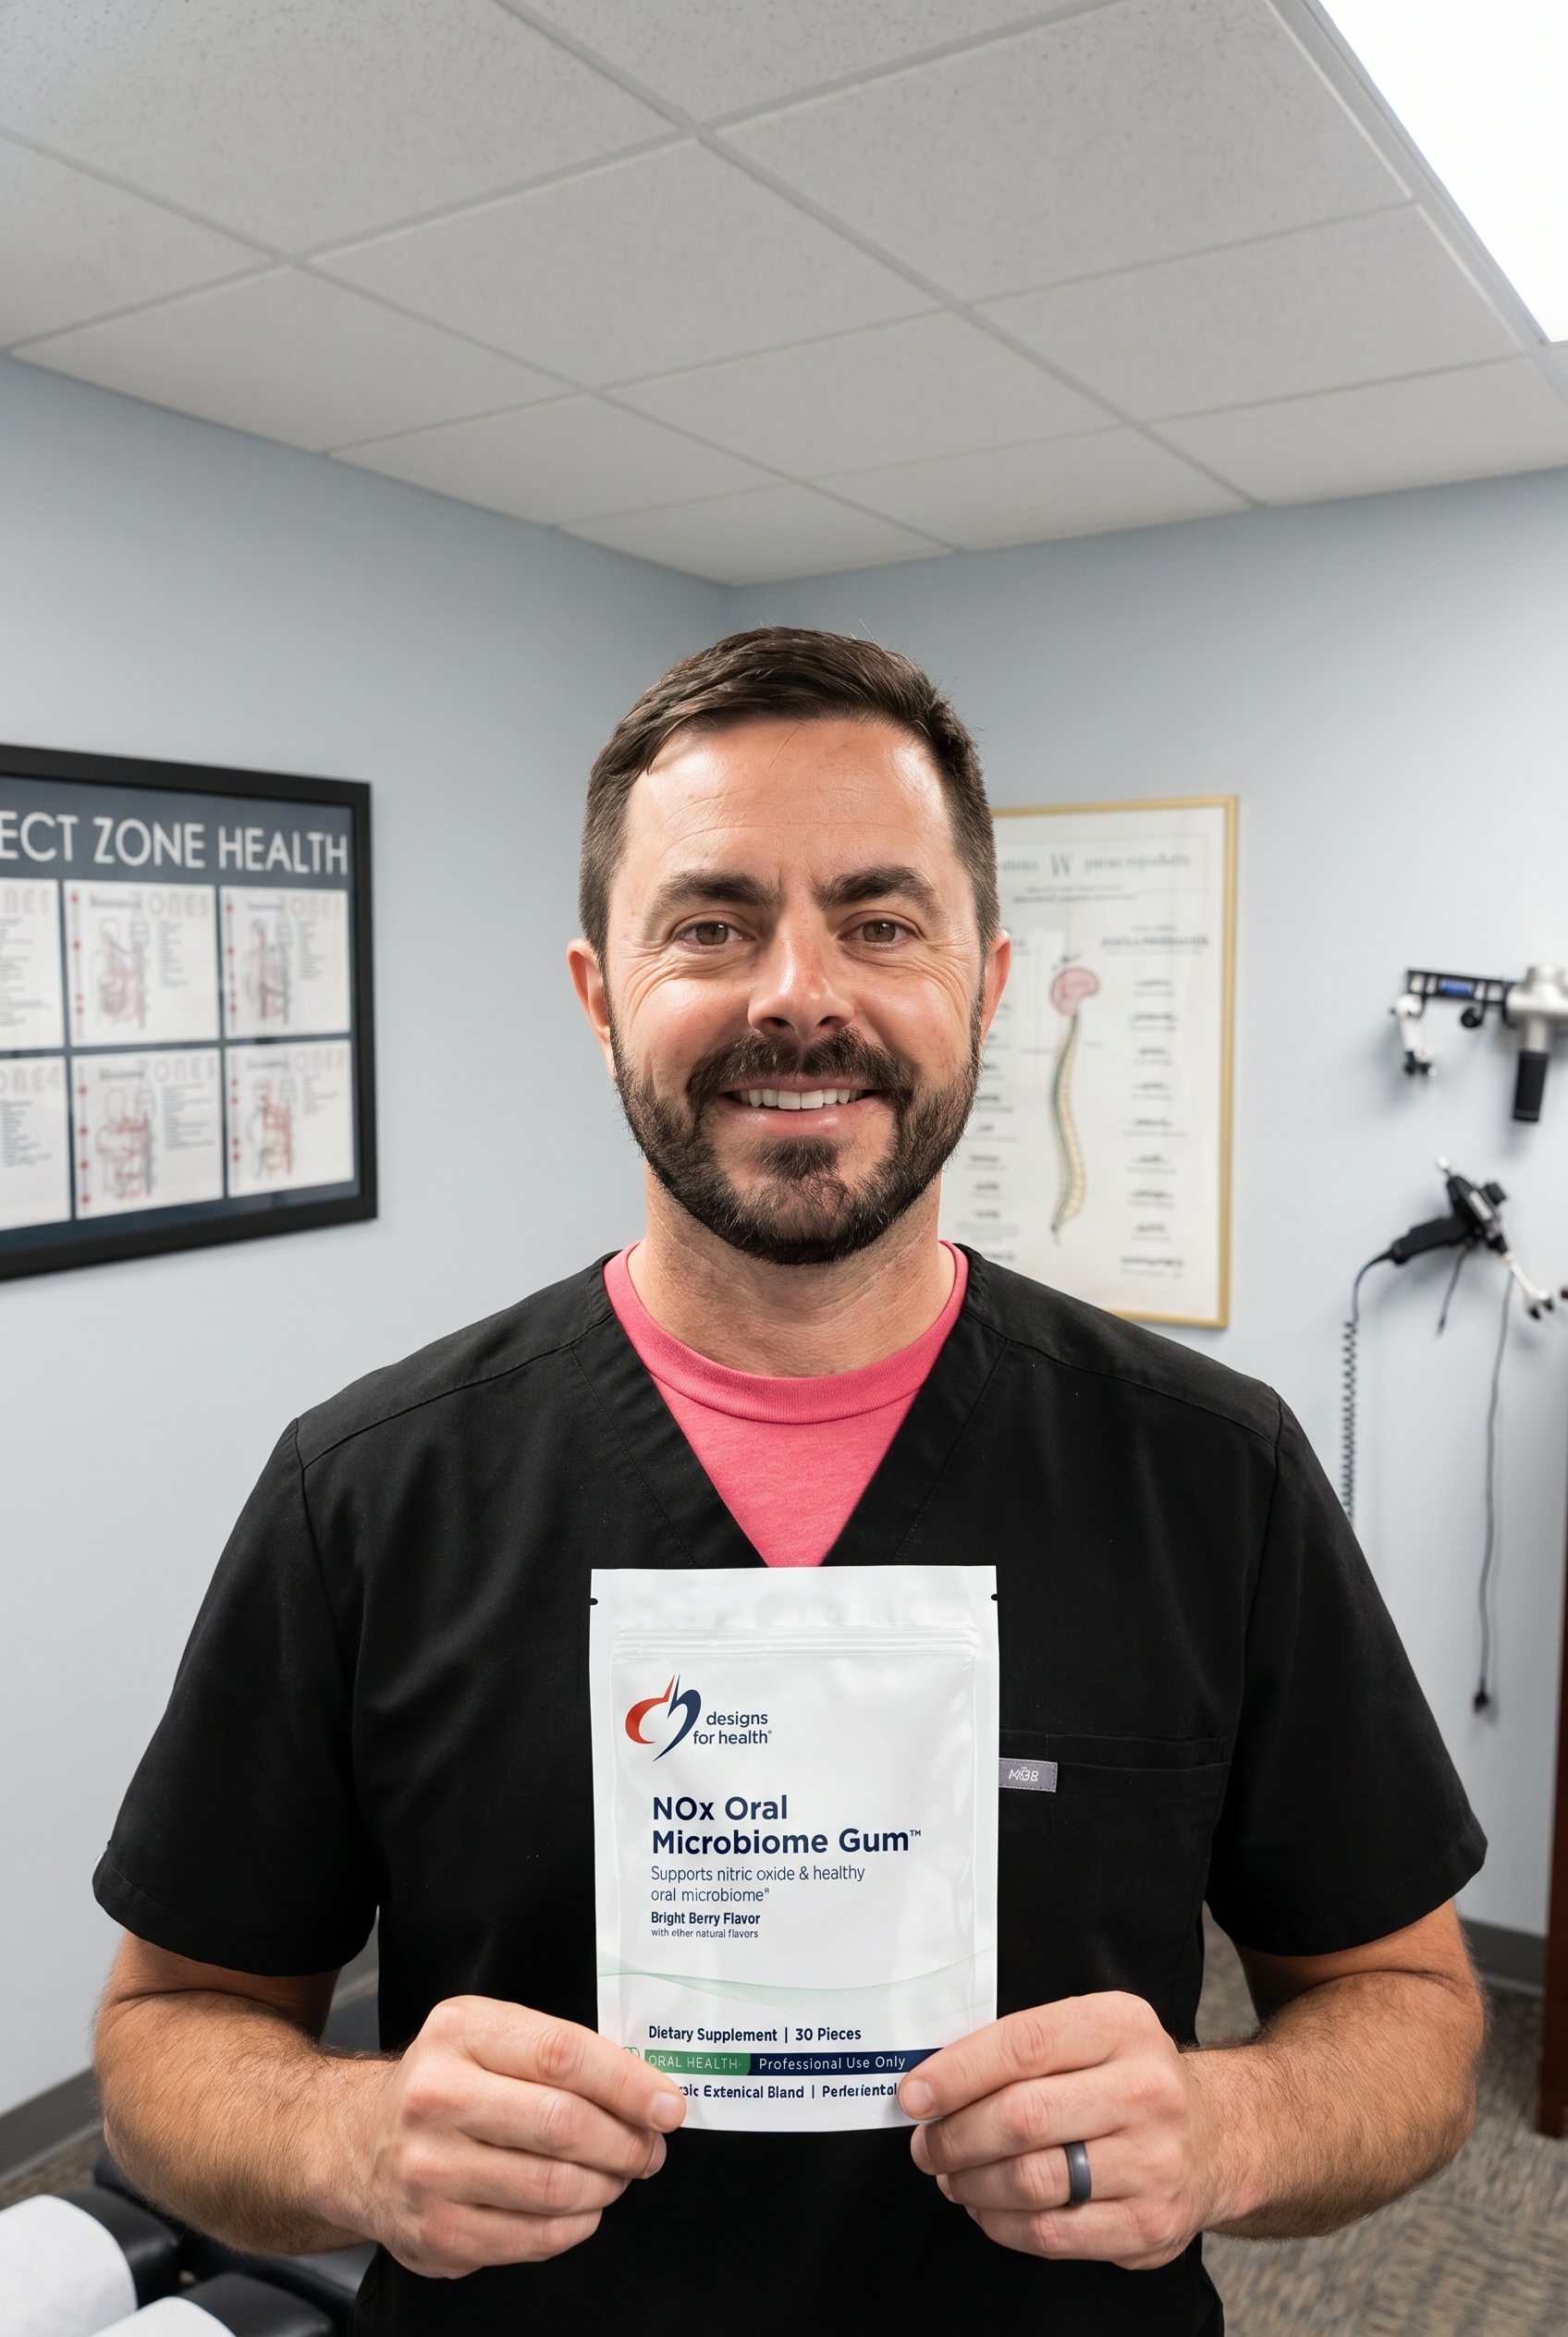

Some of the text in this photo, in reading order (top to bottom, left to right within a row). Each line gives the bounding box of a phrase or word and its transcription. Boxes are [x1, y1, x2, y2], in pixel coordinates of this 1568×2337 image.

[0, 810, 348, 875] ECT ZONE HEALTH
[705, 1710, 768, 1728] designs
[692, 1730, 716, 1744] for
[653, 1794, 788, 1821] NOx Oral
[653, 1829, 828, 1855] Microbiome
[651, 1864, 865, 1884] Supports nitric oxide & healthy
[651, 1887, 676, 1902] oral
[651, 1911, 761, 1927] Bright Berry Flavor
[651, 1927, 669, 1937] with
[648, 2025, 693, 2043] Dietary
[697, 2027, 778, 2044] Supplement
[795, 2027, 813, 2041] 30
[817, 2026, 862, 2041] Pieces
[648, 2054, 682, 2068] ORAL
[759, 2057, 842, 2071] Professional
[846, 2057, 870, 2069] Use
[875, 2055, 906, 2070] Only
[704, 2085, 764, 2098] Extenical
[767, 2085, 804, 2098] Bland
